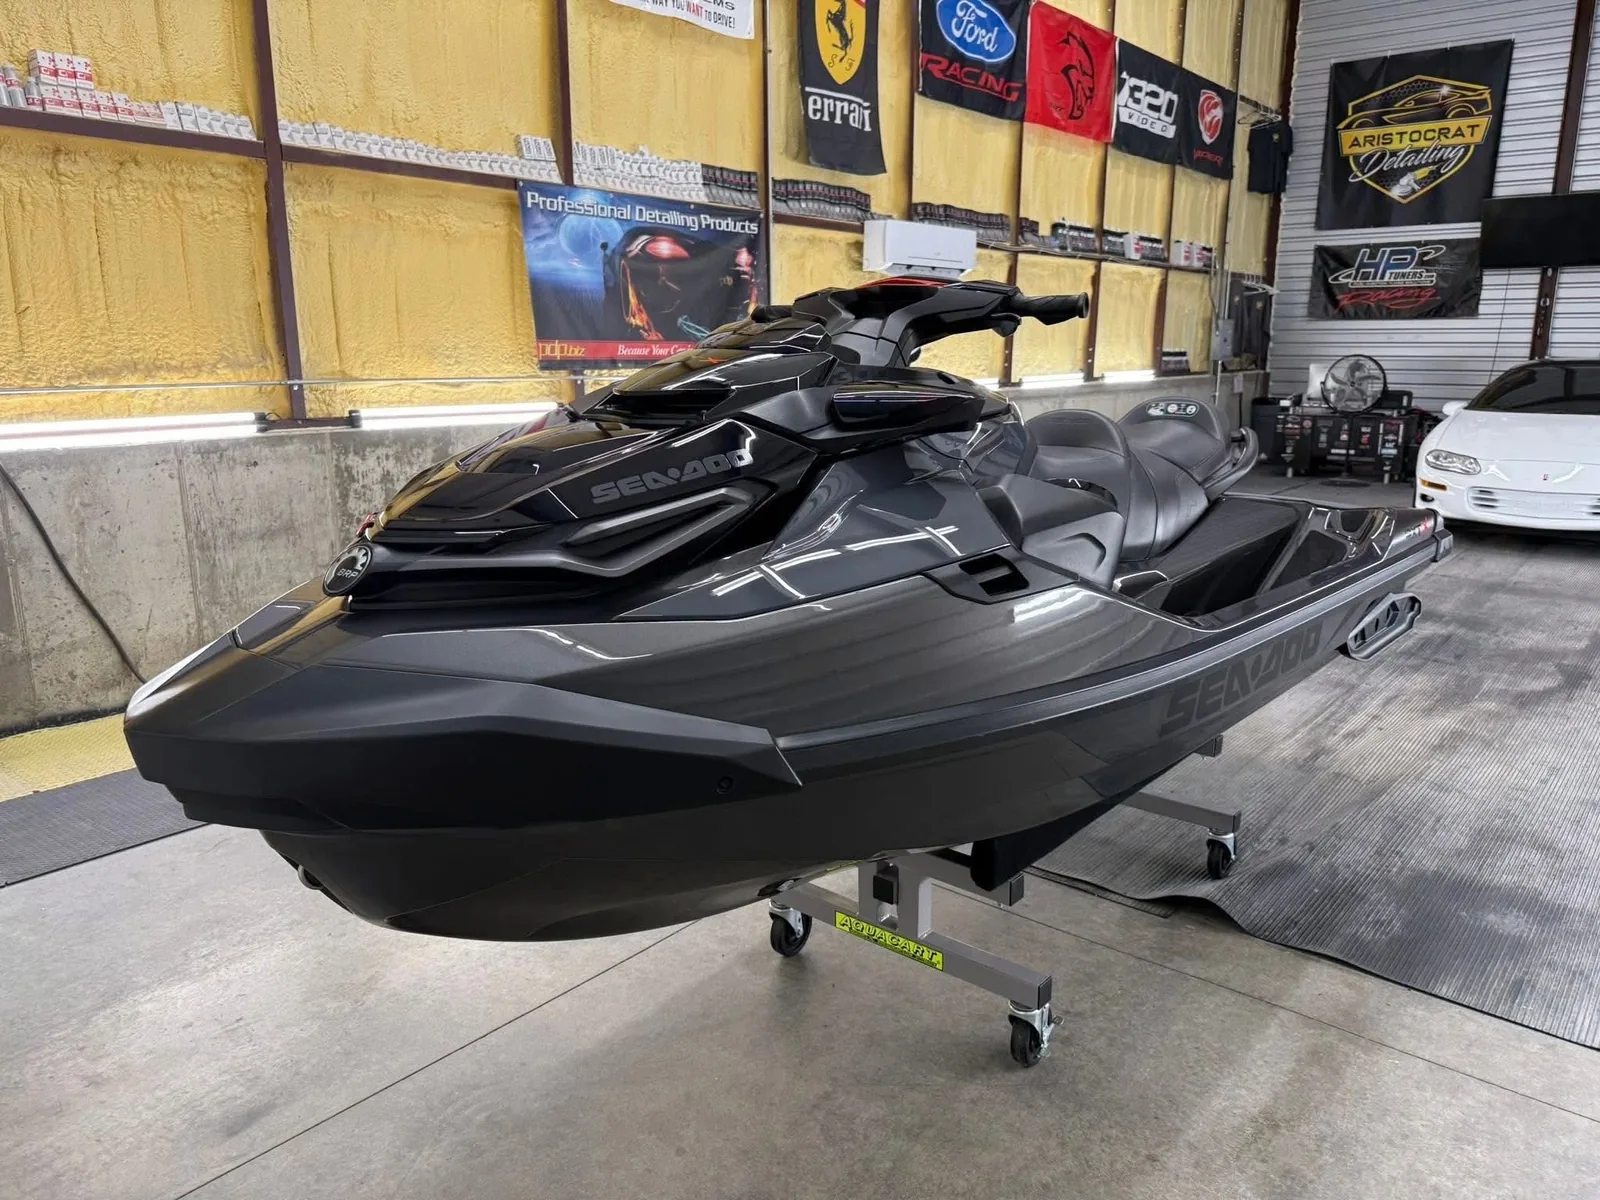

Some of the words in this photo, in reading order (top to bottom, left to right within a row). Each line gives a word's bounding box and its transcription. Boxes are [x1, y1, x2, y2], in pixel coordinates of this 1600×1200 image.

[686, 3, 703, 17] WANT
[704, 10, 712, 21] TO
[713, 11, 736, 28] DRIVE!
[951, 0, 999, 53] Ford
[921, 52, 1024, 102] RACING
[1127, 111, 1169, 134] VIDEO
[1348, 124, 1480, 149] ARISTOCRAT
[1348, 139, 1466, 182] Detailing
[526, 190, 631, 219] Professional
[635, 206, 699, 231] Detailing
[700, 214, 758, 234] Products
[1353, 246, 1419, 281] HP
[538, 340, 585, 360] pdp.biz
[617, 344, 650, 356] Because
[651, 344, 669, 356] Your
[337, 569, 359, 579] BRP
[840, 915, 938, 962] AQUACART
